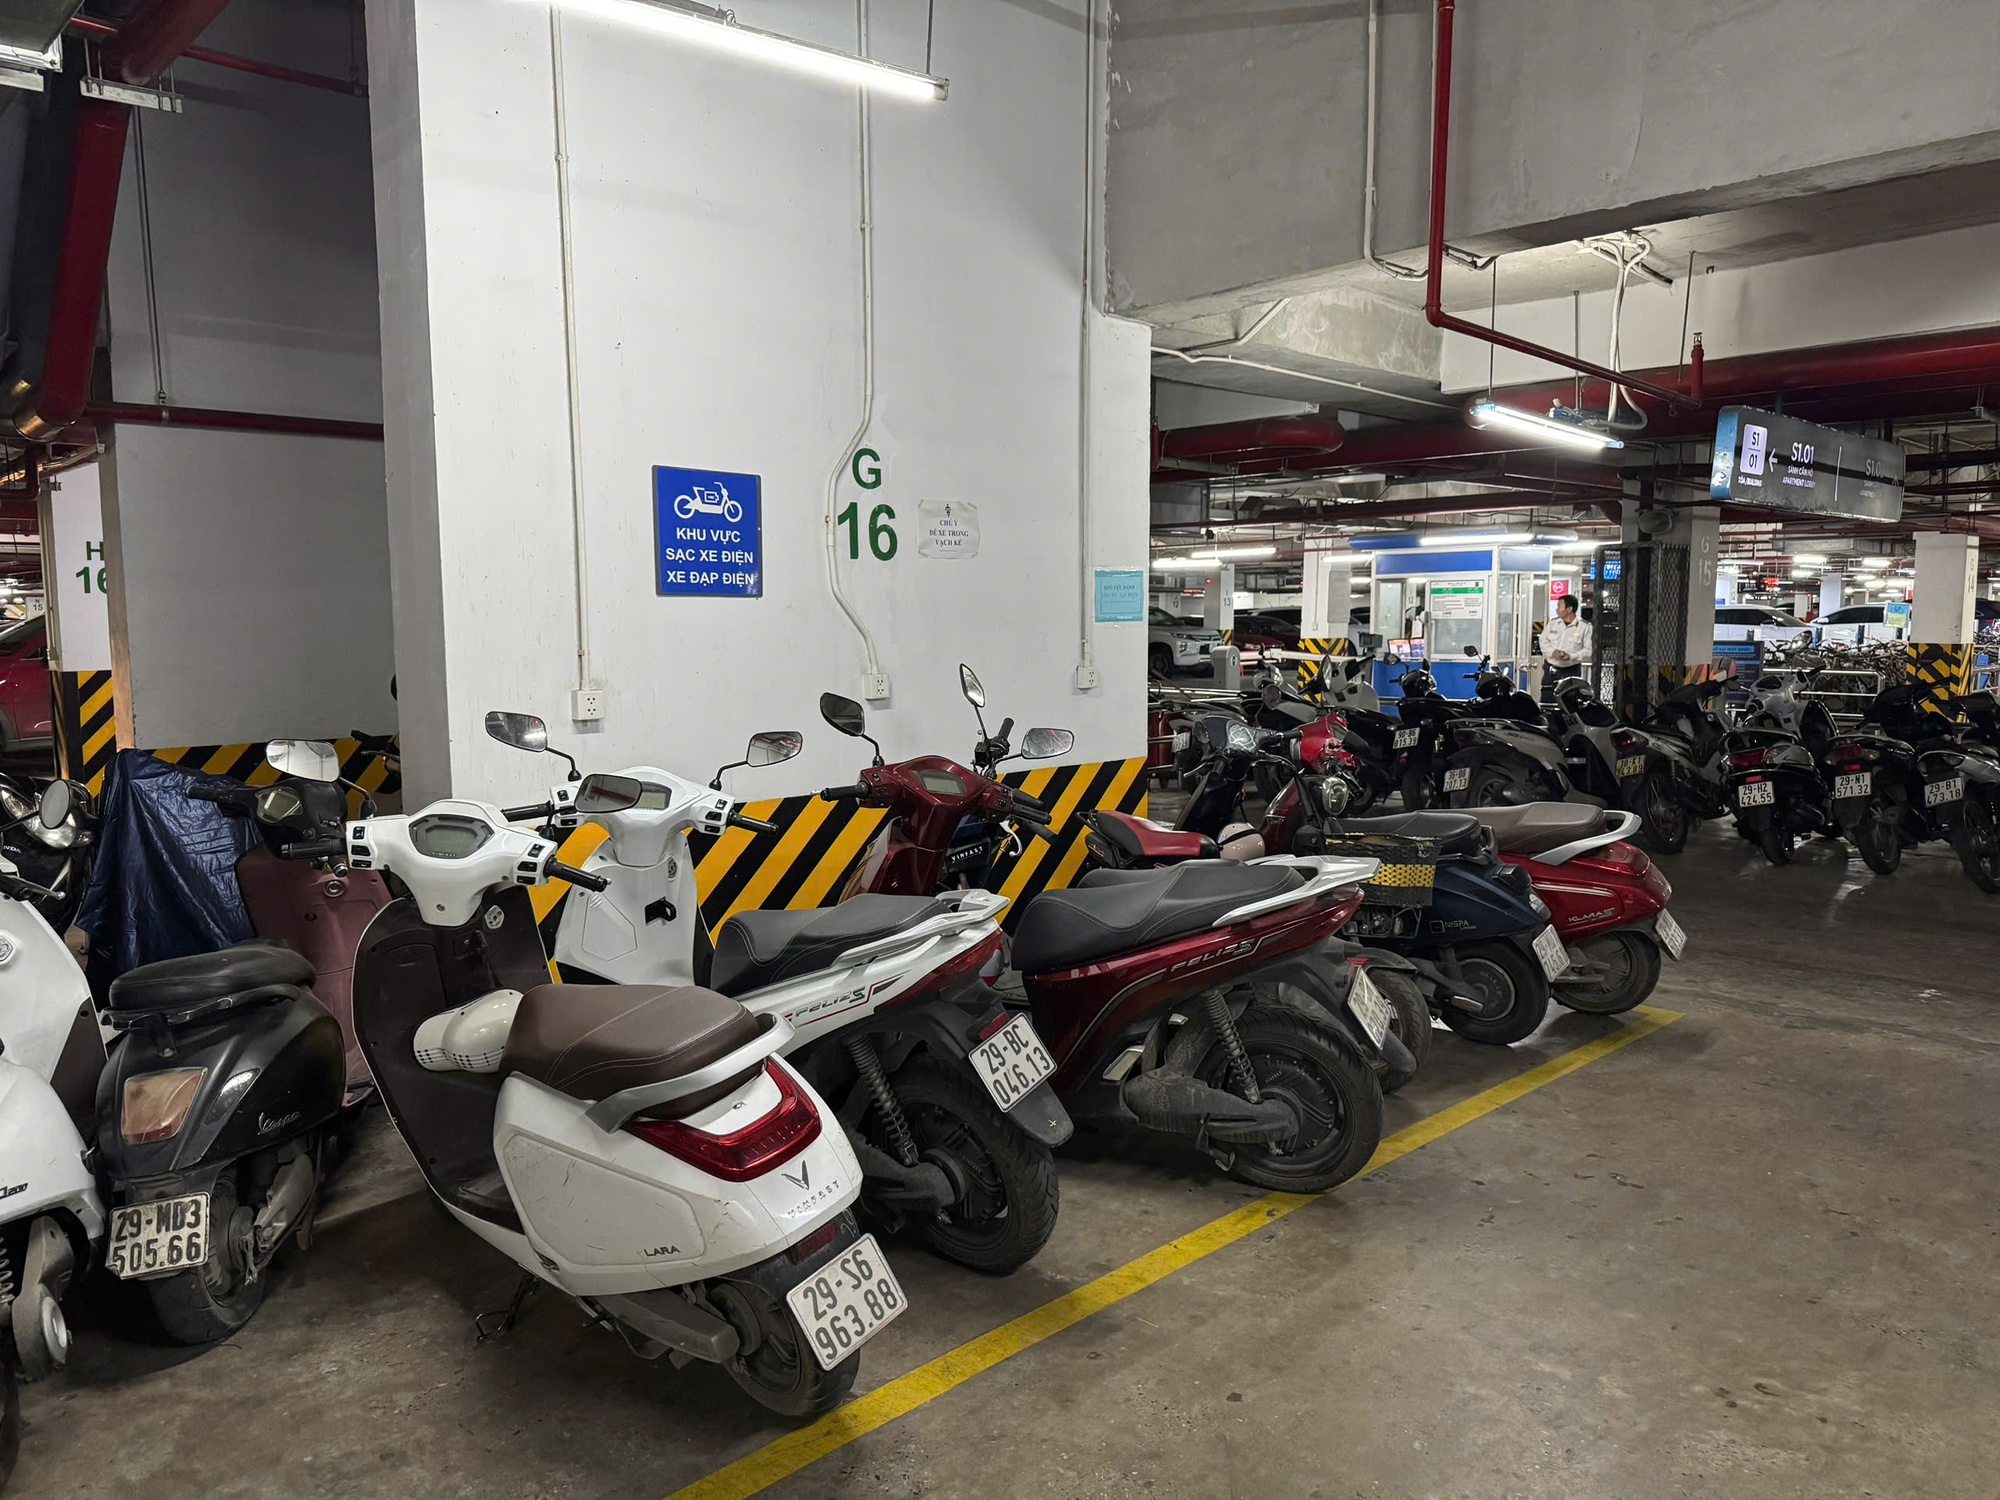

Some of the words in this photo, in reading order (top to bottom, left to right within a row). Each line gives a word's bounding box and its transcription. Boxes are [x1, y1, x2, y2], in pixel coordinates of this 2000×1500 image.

[1751, 431, 1760, 446] S1
[1791, 442, 1815, 464] S1.01
[852, 448, 882, 490] G
[676, 527, 706, 541] KHU
[710, 529, 741, 545] VỰC
[837, 502, 898, 562] 16
[86, 541, 104, 560] H
[665, 548, 696, 563] SẠC
[699, 550, 718, 562] XE
[721, 549, 754, 566] ĐIỆN
[667, 570, 686, 583] XE
[689, 571, 719, 587] ĐẠP
[722, 571, 754, 588] ĐIỆN
[33, 603, 43, 611] 15
[1743, 783, 1768, 796] 29-H2
[1840, 774, 1865, 787] 29-N1
[1929, 780, 1957, 794] 29-B1
[1741, 792, 1772, 806] 424.55
[1836, 784, 1869, 798] 571.32
[1927, 788, 1961, 806] 473.18
[979, 1023, 1029, 1075] 29-BC
[992, 1046, 1051, 1105] 046.13
[257, 1111, 300, 1136] Vespa
[114, 1198, 201, 1243] 29-MD3
[112, 1232, 201, 1273] 505.66
[643, 1245, 682, 1257] LARA
[802, 1249, 873, 1321] 29-S6
[815, 1278, 898, 1360] 963.88
